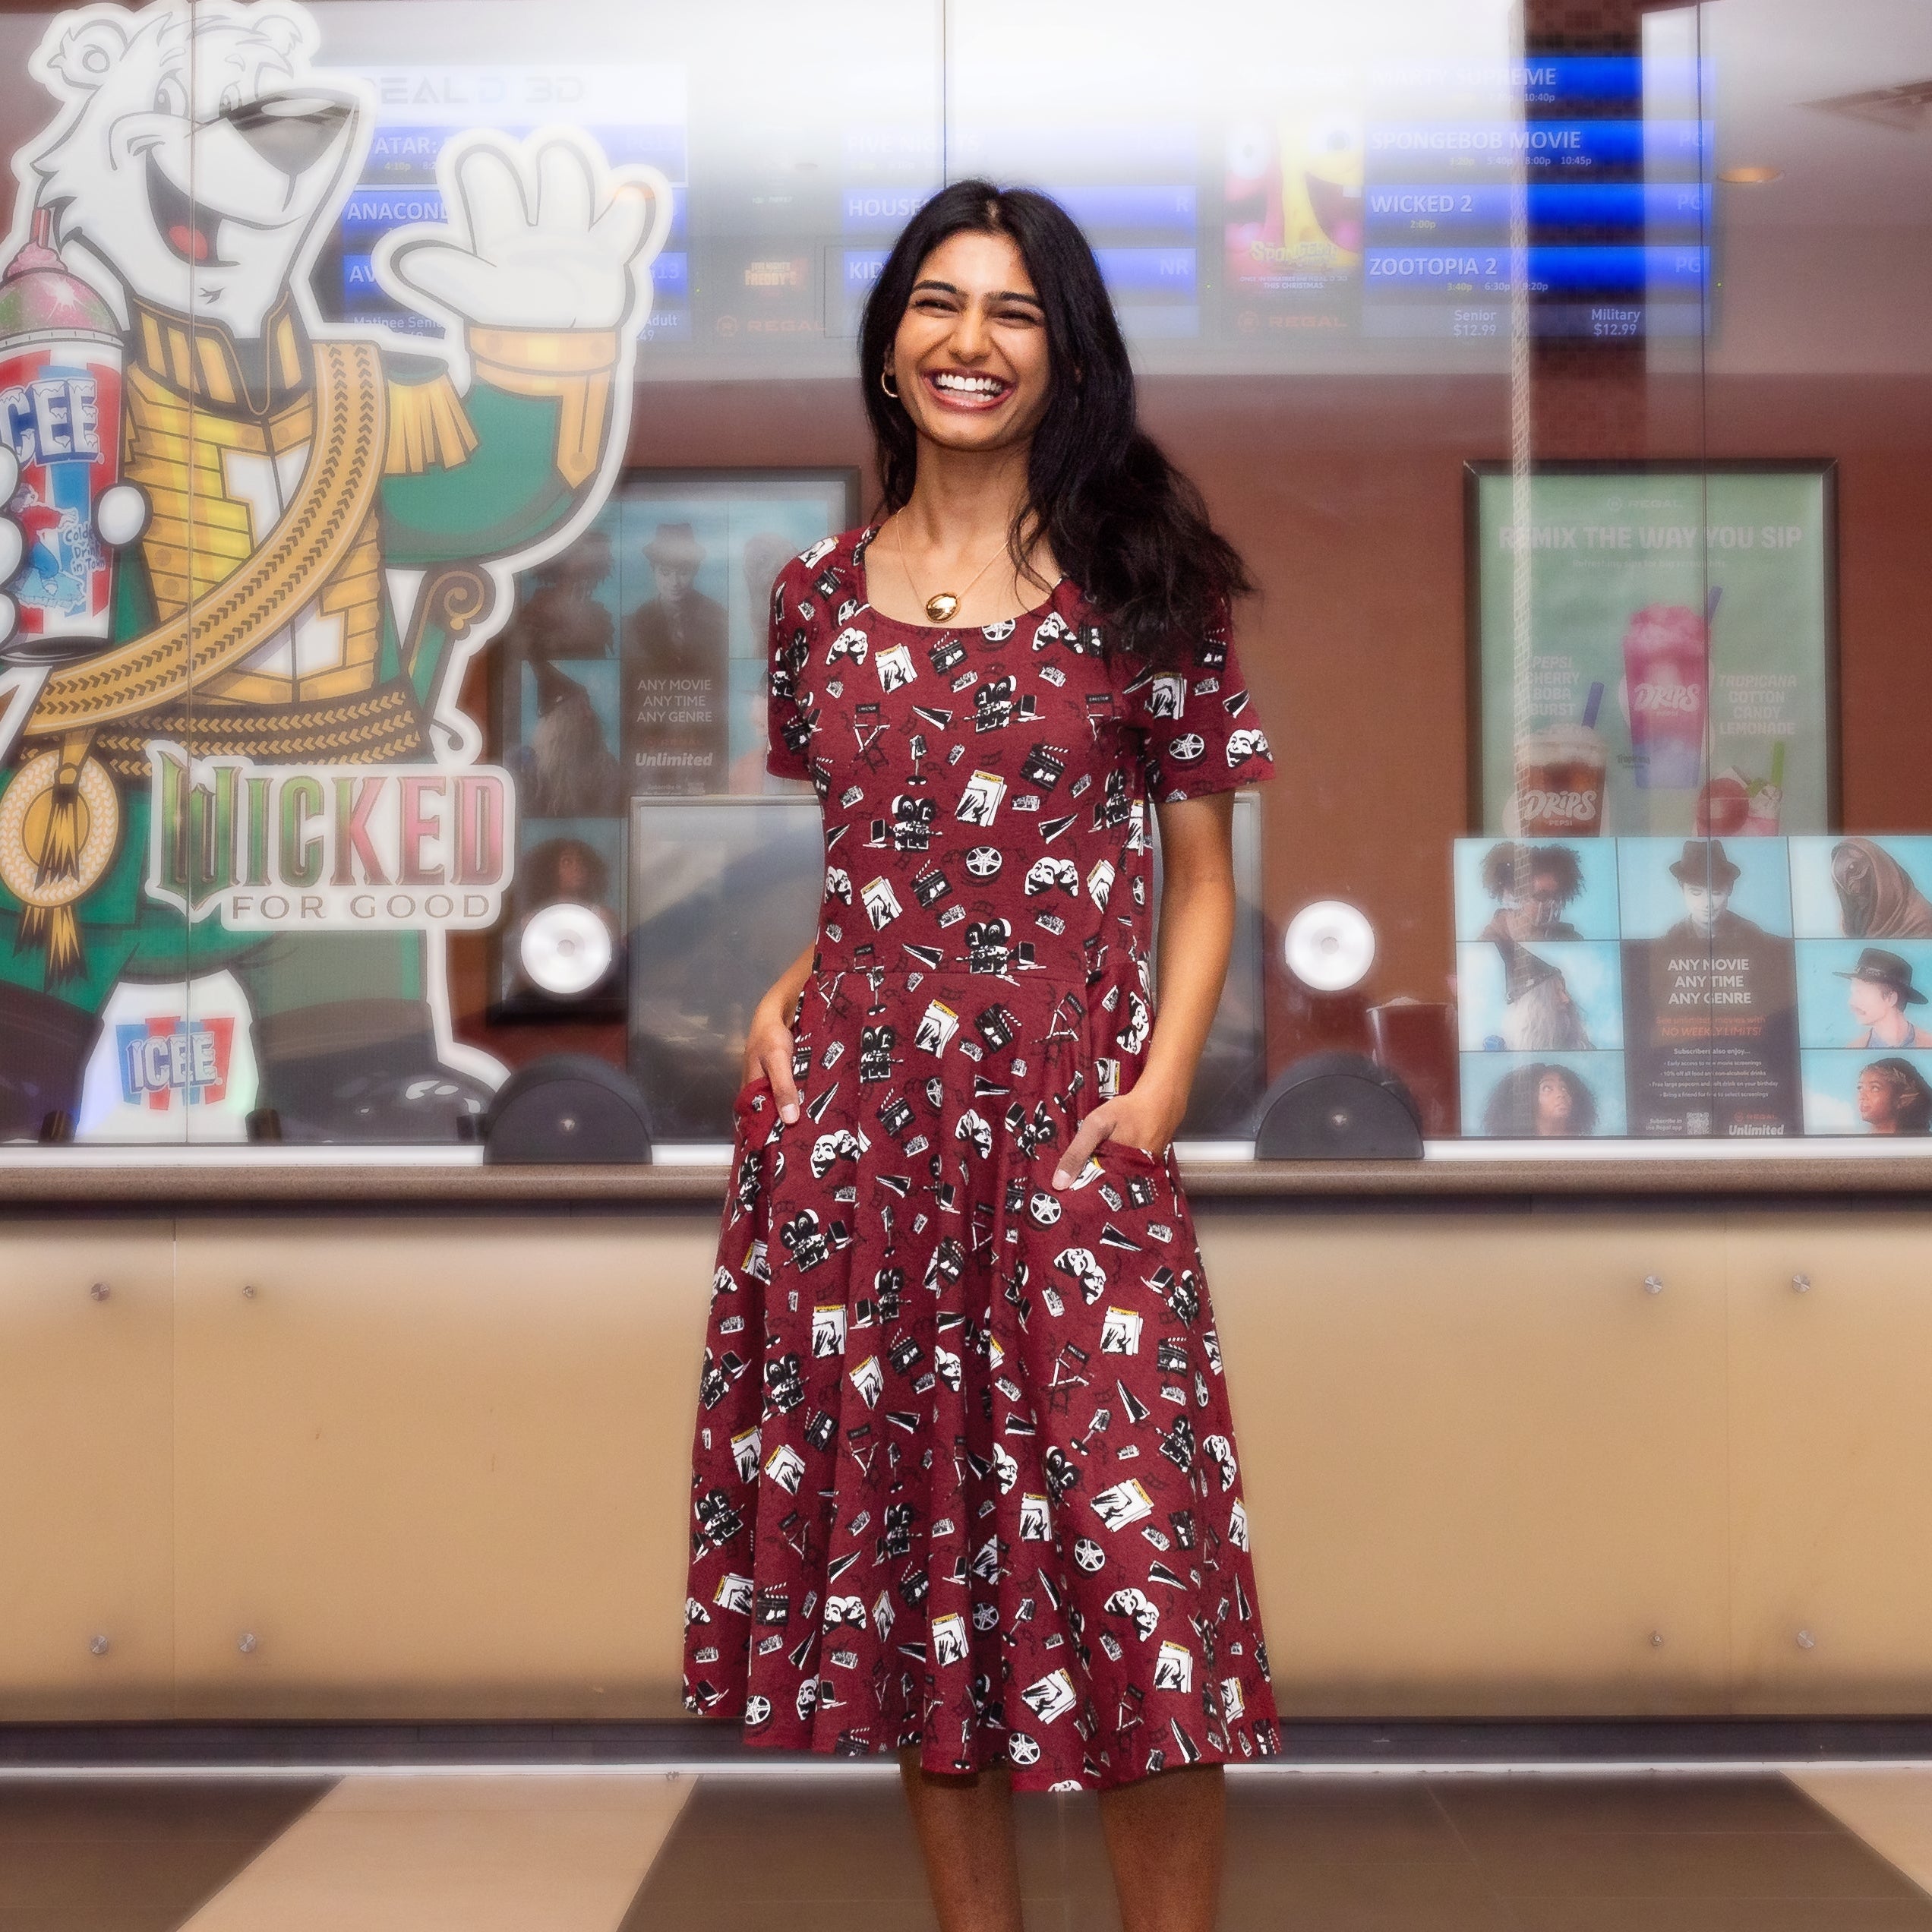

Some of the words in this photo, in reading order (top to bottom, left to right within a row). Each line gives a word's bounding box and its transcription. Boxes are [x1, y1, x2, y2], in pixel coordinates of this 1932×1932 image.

[1458, 67, 1556, 85] SUPREME
[1525, 93, 1555, 103] 10:40p
[375, 137, 438, 154] ATAR:
[1372, 131, 1503, 150] SPONGEBOB
[1510, 131, 1581, 149] MOVIE
[1487, 156, 1513, 167] 5:40p
[1561, 156, 1592, 166] 10:45p
[1176, 195, 1189, 213] R
[1370, 194, 1455, 213] WICKED
[1460, 194, 1473, 213] 2
[347, 202, 448, 221] ANACON
[1410, 219, 1436, 230] 2:00p
[1160, 257, 1189, 276] NR
[1369, 257, 1479, 276] ZOOTOPIA
[1485, 257, 1497, 276] 2
[1447, 283, 1473, 292] 3:40p
[1485, 282, 1511, 292] 6:30p
[1268, 315, 1348, 328] REGAL
[1454, 309, 1497, 321] Senior
[1591, 308, 1641, 323] Military
[747, 319, 827, 333] REGAL
[1453, 324, 1497, 338] $12.99
[1593, 323, 1637, 338] $12.99
[0, 378, 100, 465] CEE
[1627, 499, 1682, 509] REGAL
[1584, 526, 1632, 548] THE
[1638, 526, 1700, 549] WAY
[1706, 526, 1757, 549] YOU
[1760, 526, 1802, 548] SIP
[72, 560, 83, 572] in
[1532, 655, 1573, 669] PEPSI
[636, 679, 667, 691] ANY
[669, 679, 712, 691] MOVIE
[1533, 687, 1572, 700] BOBA
[1728, 690, 1785, 703] COTTON
[643, 695, 673, 707] ANY
[674, 695, 706, 707] TIME
[1530, 702, 1577, 716] BURST
[1732, 706, 1781, 719] CANDY
[636, 711, 666, 722] ANY
[668, 711, 712, 722] GENRE
[1719, 722, 1798, 735] LEMONADE
[635, 752, 714, 766] Unlimited
[157, 750, 504, 911] WICKED
[232, 894, 326, 919] FOR
[349, 894, 490, 919] GOOD
[1668, 958, 1700, 971] ANY
[1703, 958, 1750, 971] MOVIE
[1675, 975, 1709, 988] ANY
[1709, 975, 1744, 988] TIME
[1668, 992, 1702, 1005] ANY
[1703, 992, 1752, 1005] GENRE
[1662, 1027, 1678, 1037] NO
[1725, 1027, 1762, 1037] LIMITS!
[128, 1031, 217, 1093] ICEE
[1728, 1125, 1785, 1135] Unlimited
